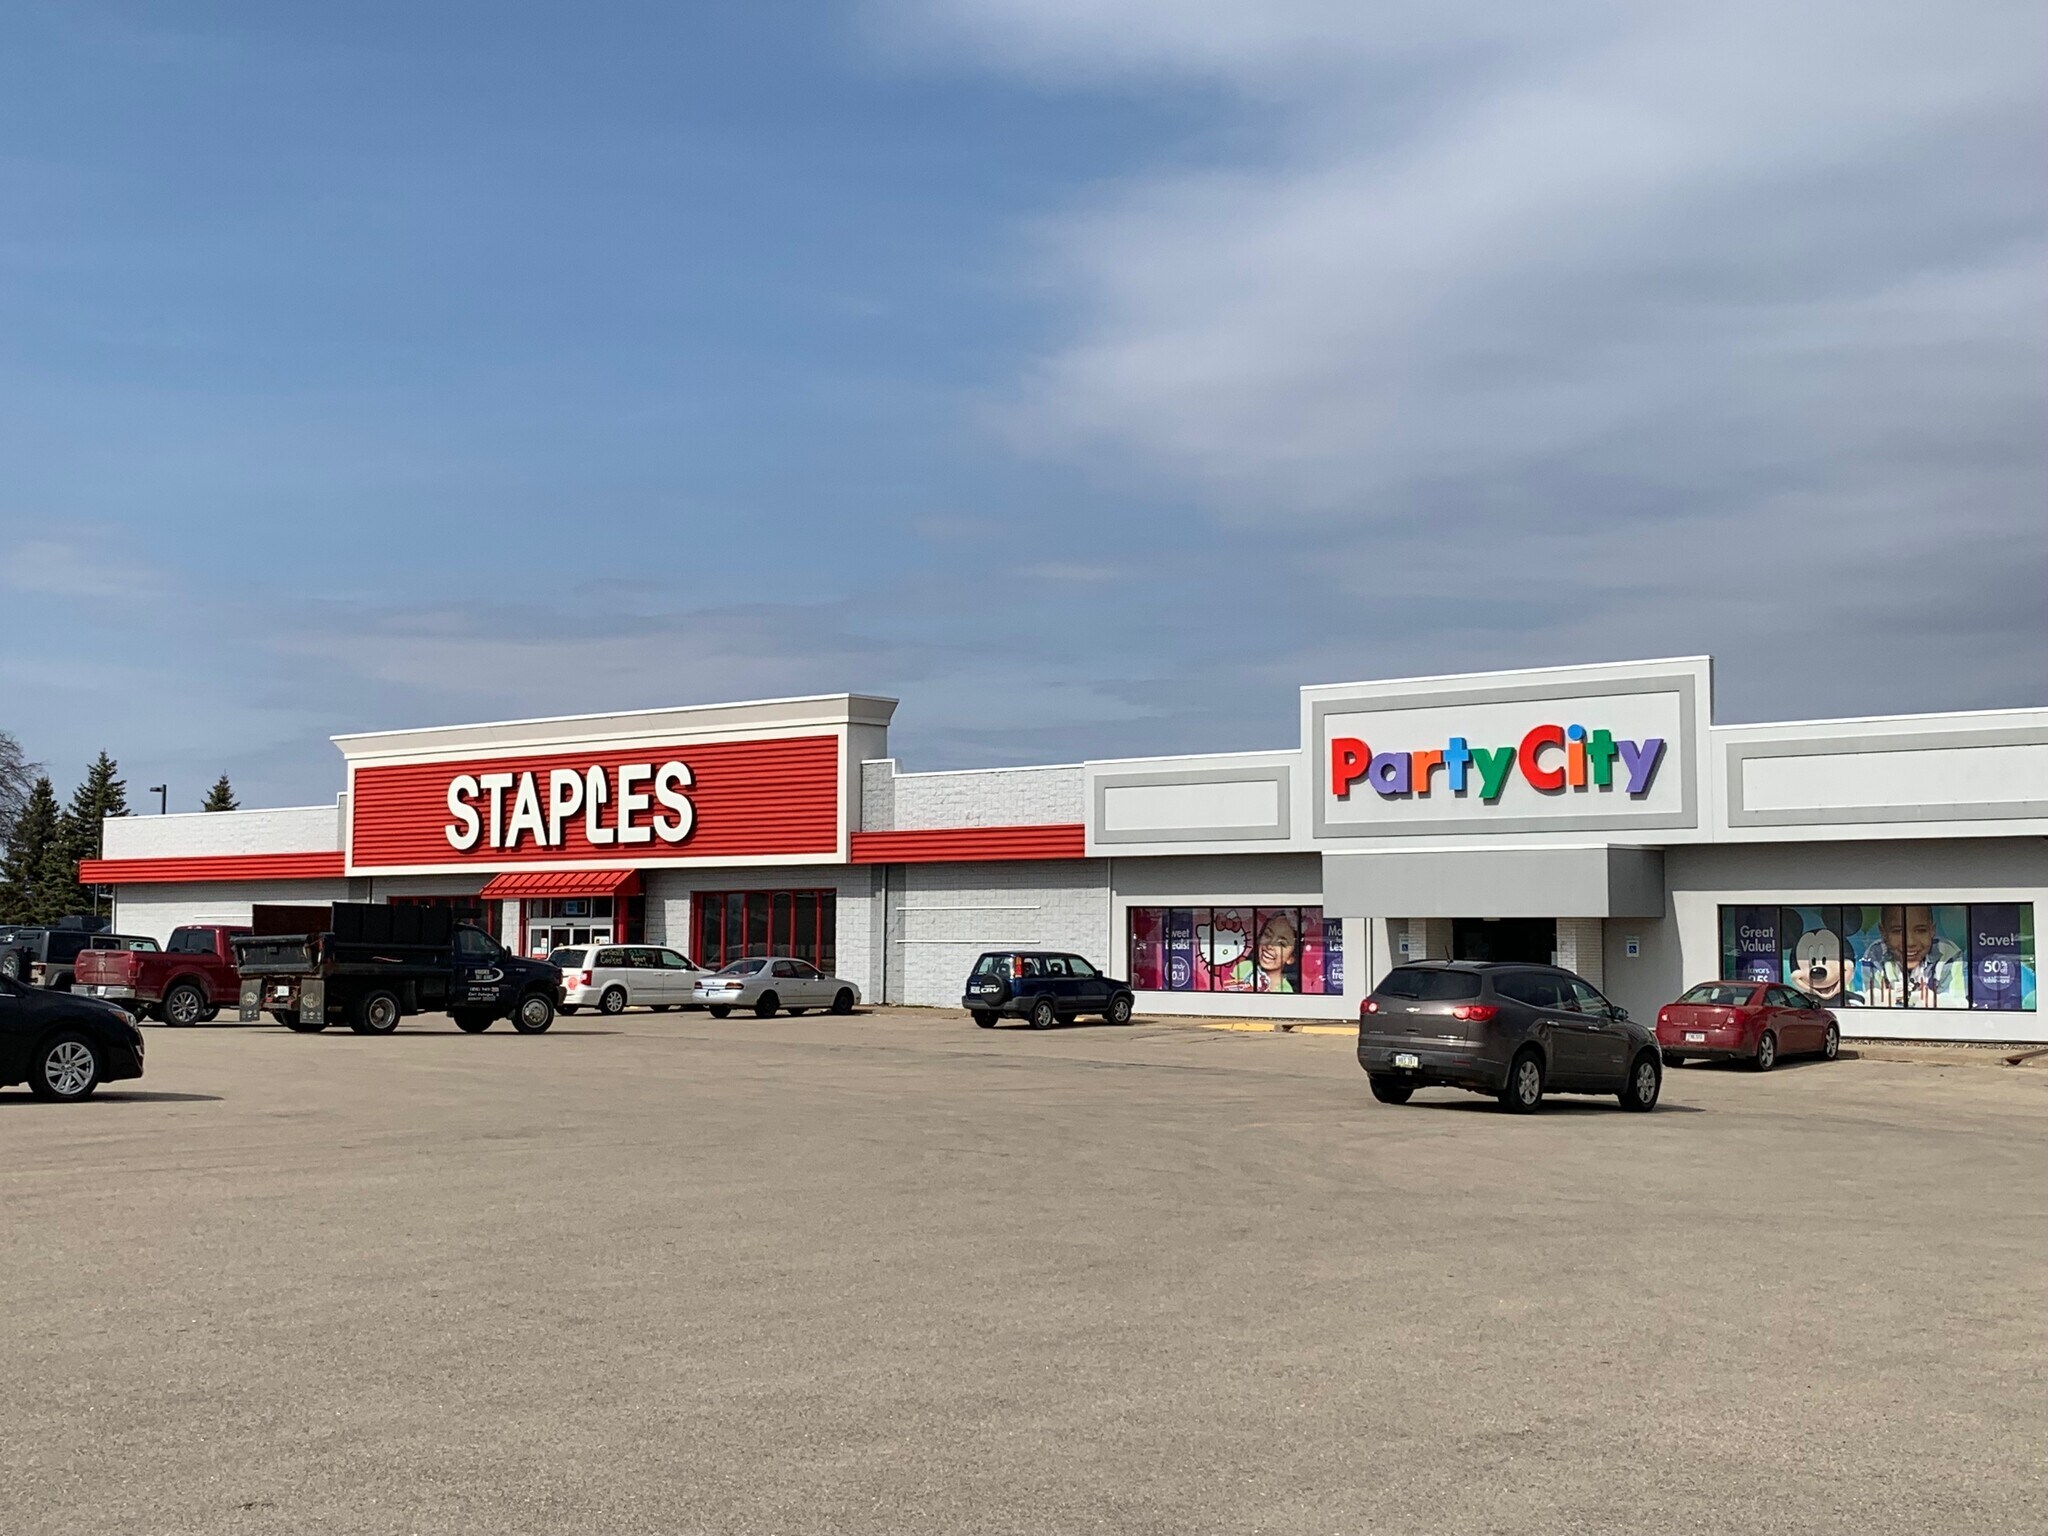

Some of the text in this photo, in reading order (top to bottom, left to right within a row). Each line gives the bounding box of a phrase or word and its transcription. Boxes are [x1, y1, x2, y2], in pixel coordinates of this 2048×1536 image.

[445, 761, 693, 850] STAPLES
[1740, 925, 1774, 938] Great
[1741, 939, 1776, 952] Value!
[1979, 932, 2014, 946] Save!
